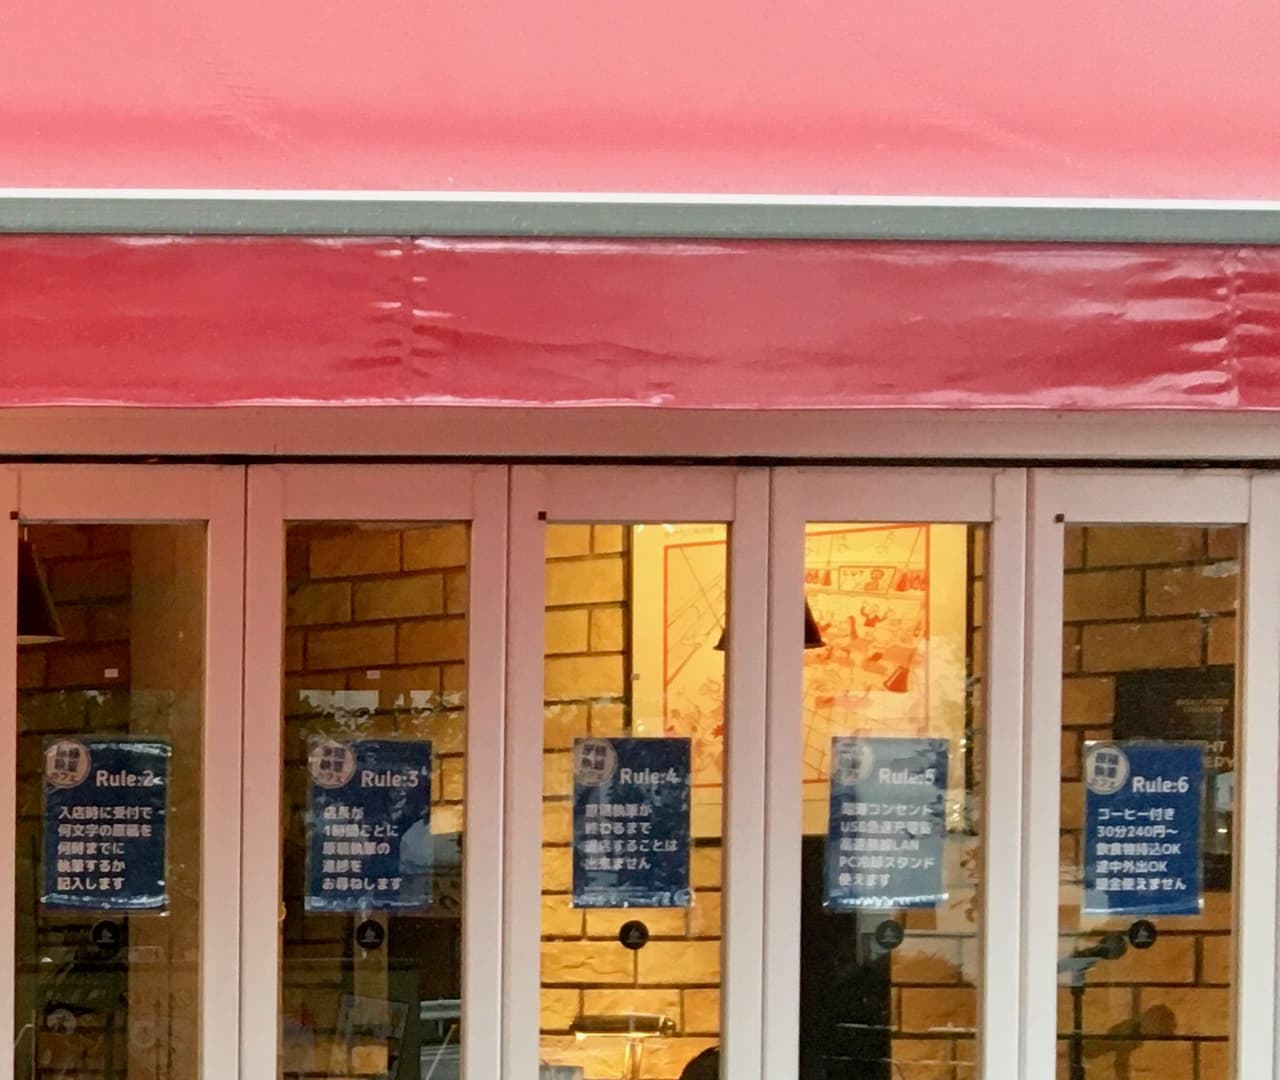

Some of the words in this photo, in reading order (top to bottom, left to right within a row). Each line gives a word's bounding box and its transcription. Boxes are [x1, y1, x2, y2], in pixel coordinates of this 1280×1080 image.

[96, 770, 154, 787] Rule:2
[361, 770, 419, 787] Rule:3
[620, 767, 681, 785] Rule:4
[1132, 776, 1189, 793] Rule:6
[58, 806, 153, 820] 入店時に受付で
[323, 806, 365, 820] 店長が
[1097, 808, 1175, 821] コーヒー付き
[57, 824, 153, 837] 何文字の原稿を
[324, 824, 399, 837] 1時間ごとに
[585, 822, 652, 835] 終わるまで
[57, 842, 125, 855] 何時までに
[1096, 843, 1181, 856] 飲食物持込OK
[57, 859, 125, 873] 執筆するか
[584, 857, 651, 871] 出来ません
[1096, 860, 1168, 873] 途中外出OK
[57, 877, 125, 890] 記入します
[322, 877, 402, 891] お尋ねします
[838, 873, 891, 887] 使えます
[1096, 878, 1187, 891] 現金使えません
